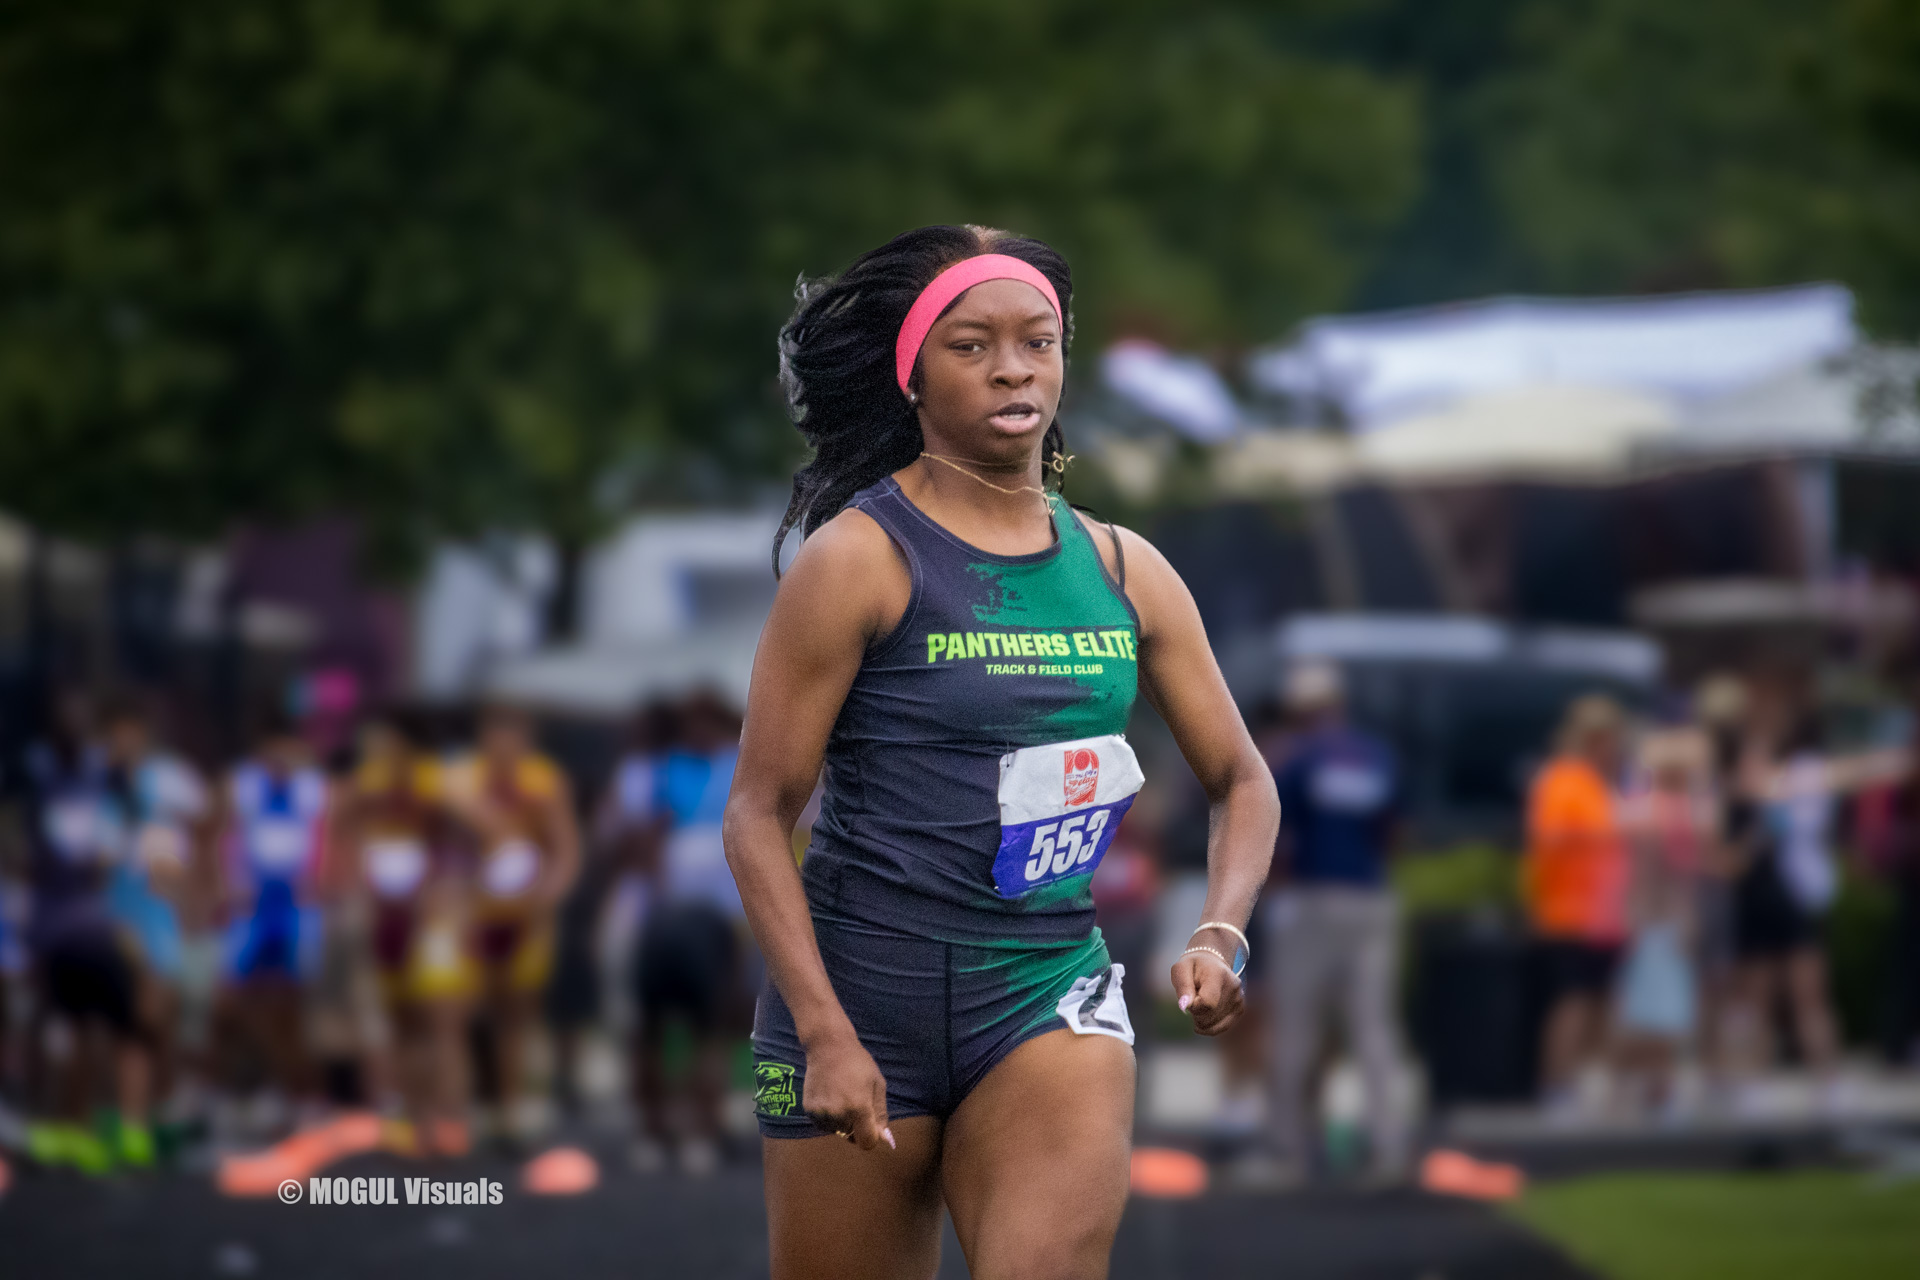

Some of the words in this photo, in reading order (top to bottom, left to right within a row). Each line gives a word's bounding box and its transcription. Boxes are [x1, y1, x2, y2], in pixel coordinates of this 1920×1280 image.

[927, 632, 1071, 663] PANTHERS
[1072, 630, 1136, 661] ELITE
[986, 664, 1026, 675] TRACK
[1028, 664, 1037, 675] &
[1039, 664, 1072, 675] FIELD
[1074, 664, 1104, 674] CLUB
[1024, 809, 1111, 881] 553
